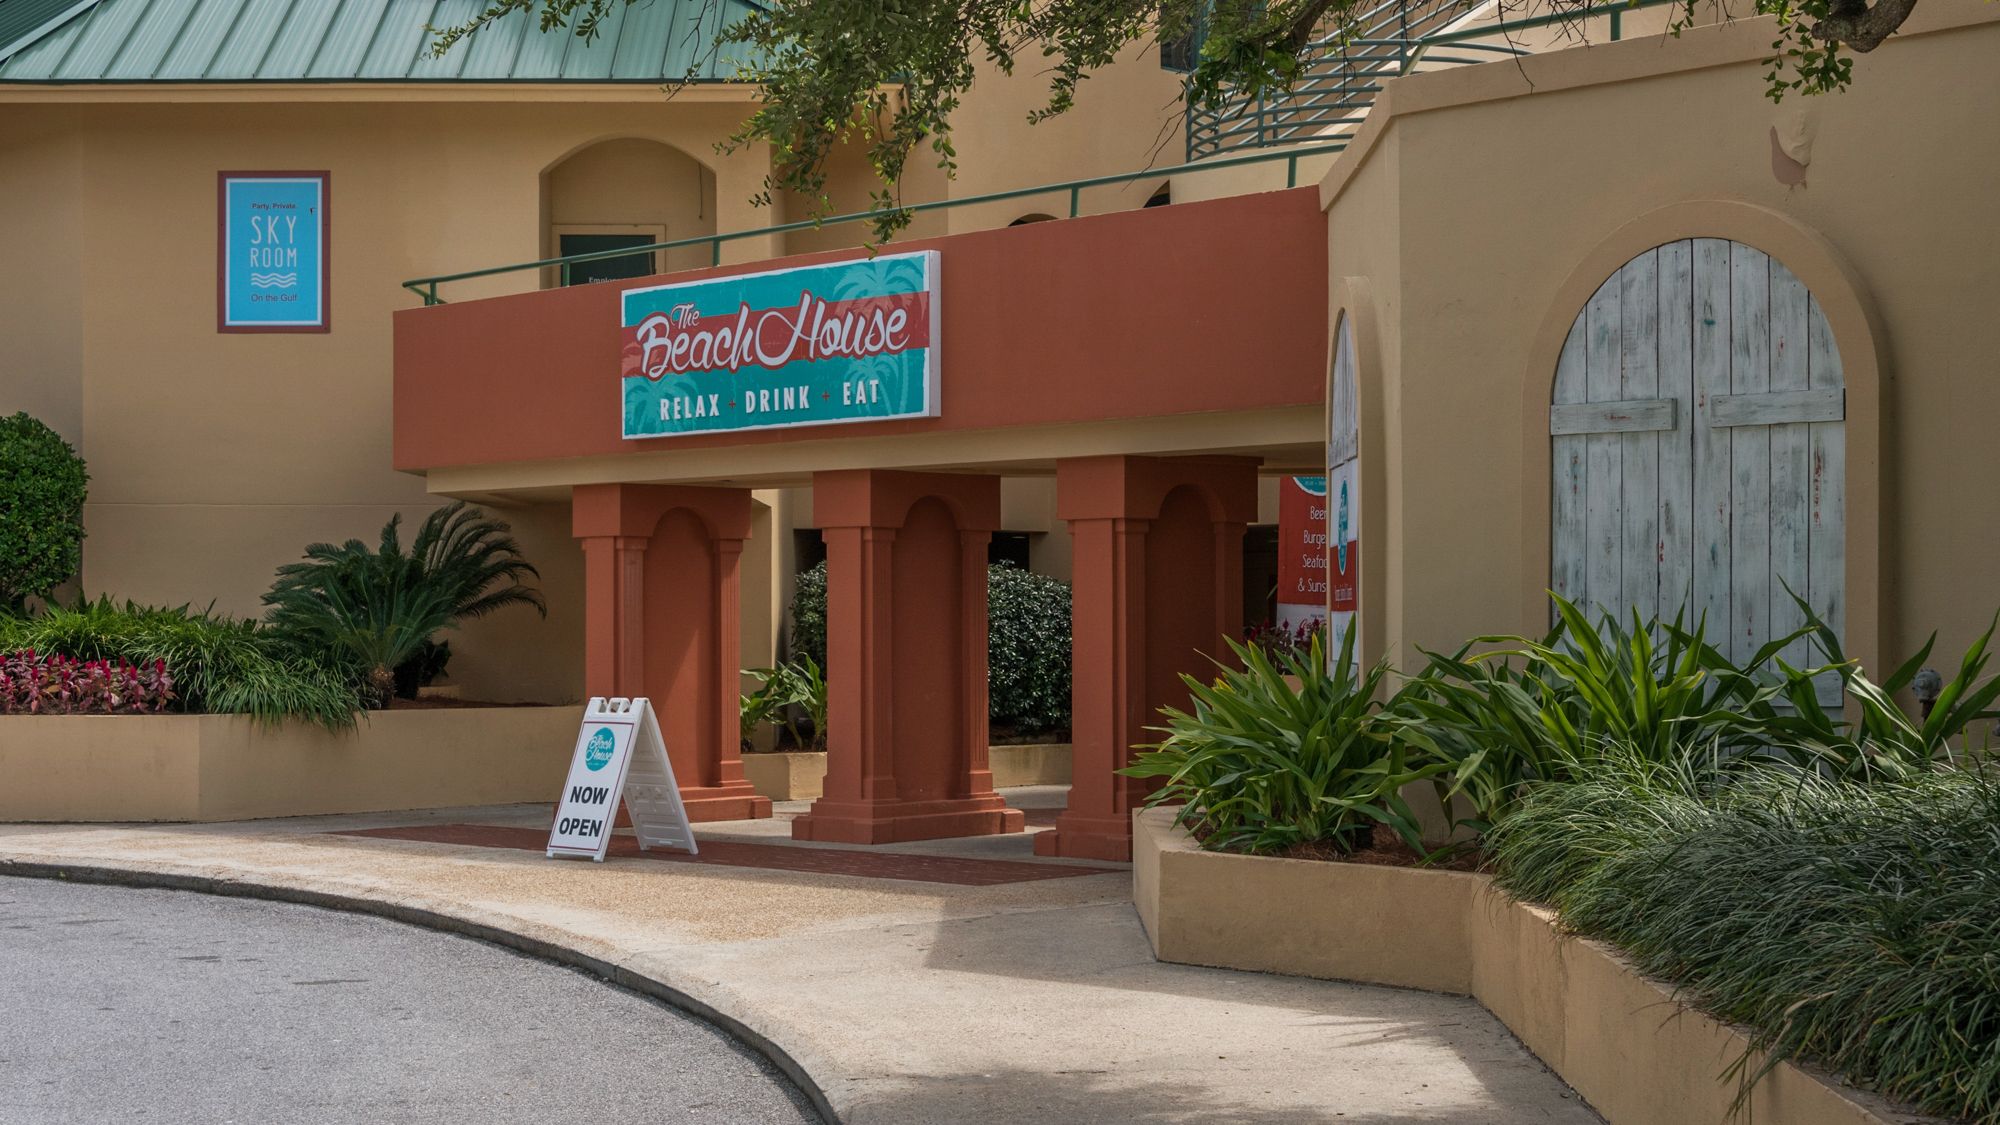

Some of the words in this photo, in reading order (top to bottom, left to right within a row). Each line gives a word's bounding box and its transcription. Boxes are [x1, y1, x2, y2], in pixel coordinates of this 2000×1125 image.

[251, 216, 297, 244] SKY
[251, 248, 297, 267] ROOM
[251, 294, 263, 302] On
[670, 303, 700, 327] The
[637, 305, 754, 376] Beach
[755, 293, 910, 365] House
[660, 394, 720, 421] RELAX
[745, 385, 810, 413] DRINK
[843, 380, 879, 406] EAT
[1303, 529, 1326, 550] Burge
[1298, 577, 1305, 592] &
[1307, 578, 1327, 592] Suns
[569, 786, 609, 805] NOW
[559, 817, 602, 837] OPEN
